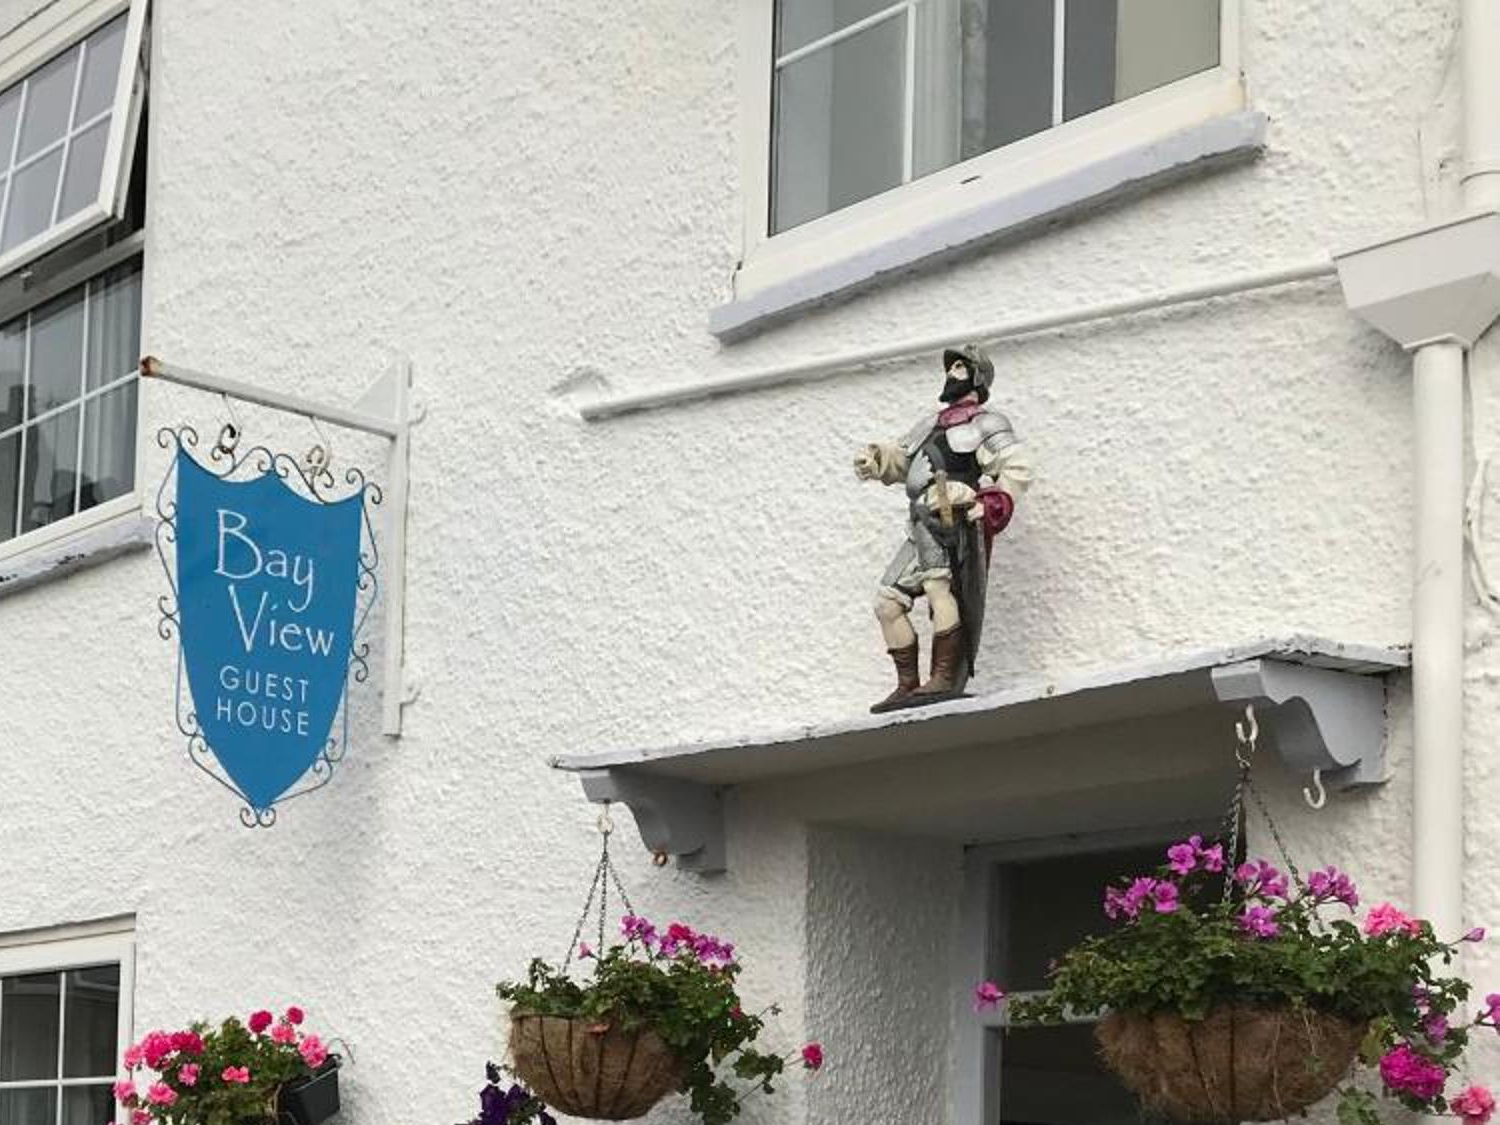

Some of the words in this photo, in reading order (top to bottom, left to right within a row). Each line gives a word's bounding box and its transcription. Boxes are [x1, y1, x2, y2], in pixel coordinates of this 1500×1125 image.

[214, 508, 314, 612] Bay
[228, 584, 335, 658] View
[219, 664, 310, 704] GUEST
[216, 695, 310, 736] HOUSE
